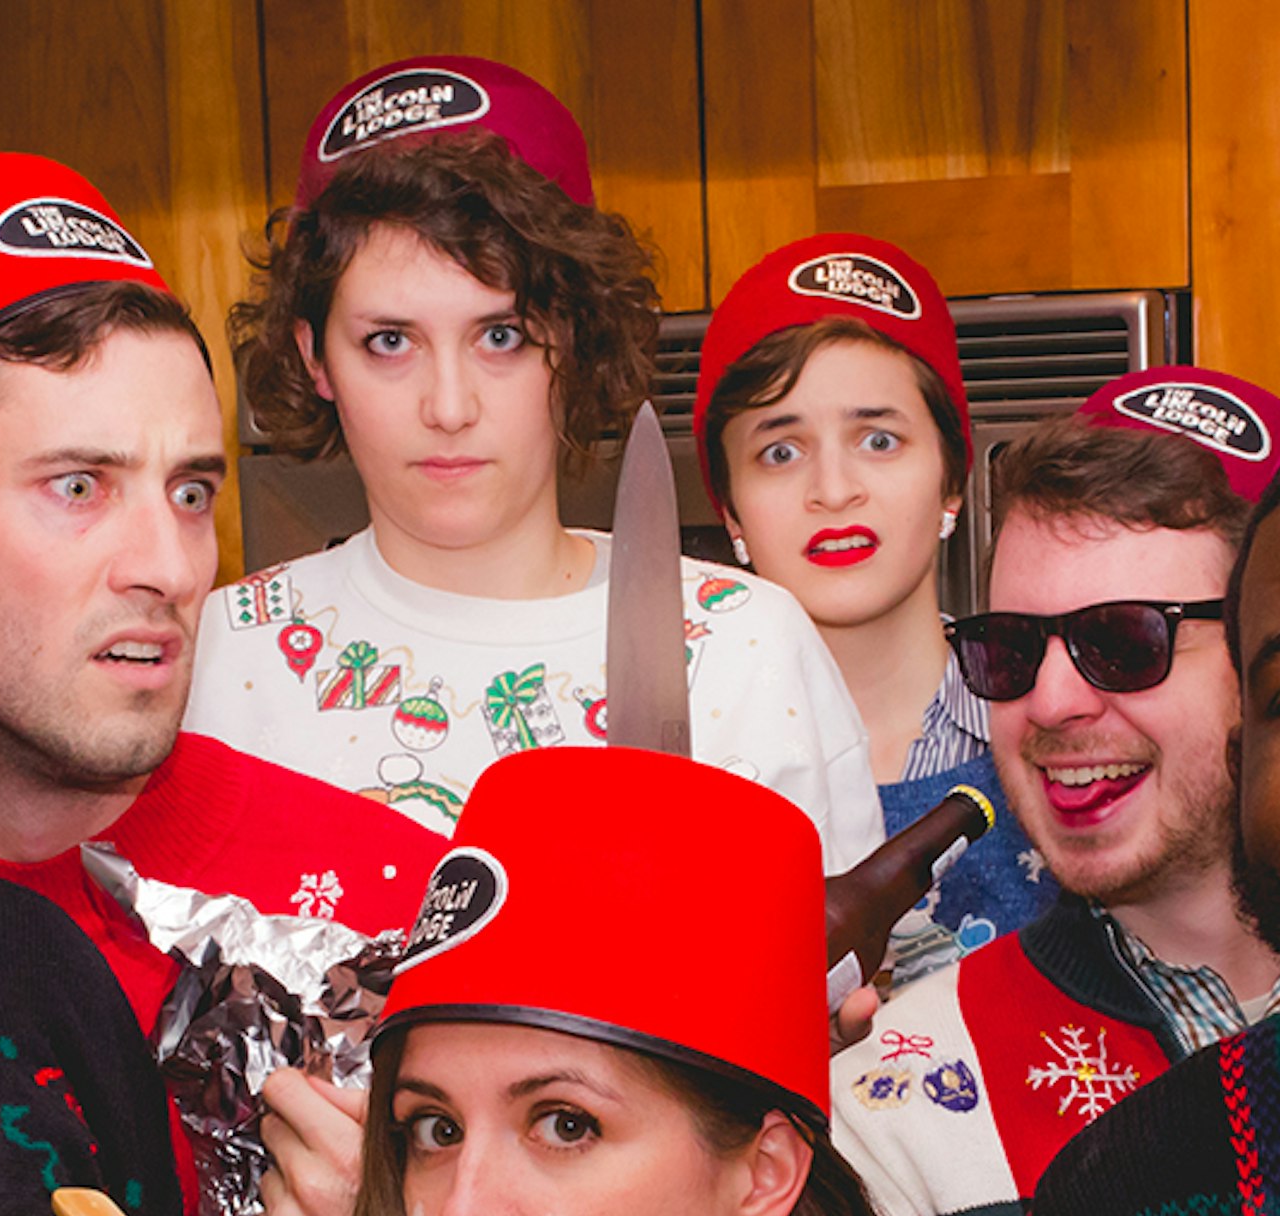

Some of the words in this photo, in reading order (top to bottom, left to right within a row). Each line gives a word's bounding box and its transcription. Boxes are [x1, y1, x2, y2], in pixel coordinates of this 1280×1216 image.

[342, 84, 454, 136] LINCOLN
[355, 104, 442, 141] LODGE
[815, 266, 900, 298] LINCOLN
[828, 280, 893, 309] LODGE
[1144, 393, 1246, 436] LINCOLN
[1152, 406, 1231, 446] LODGE
